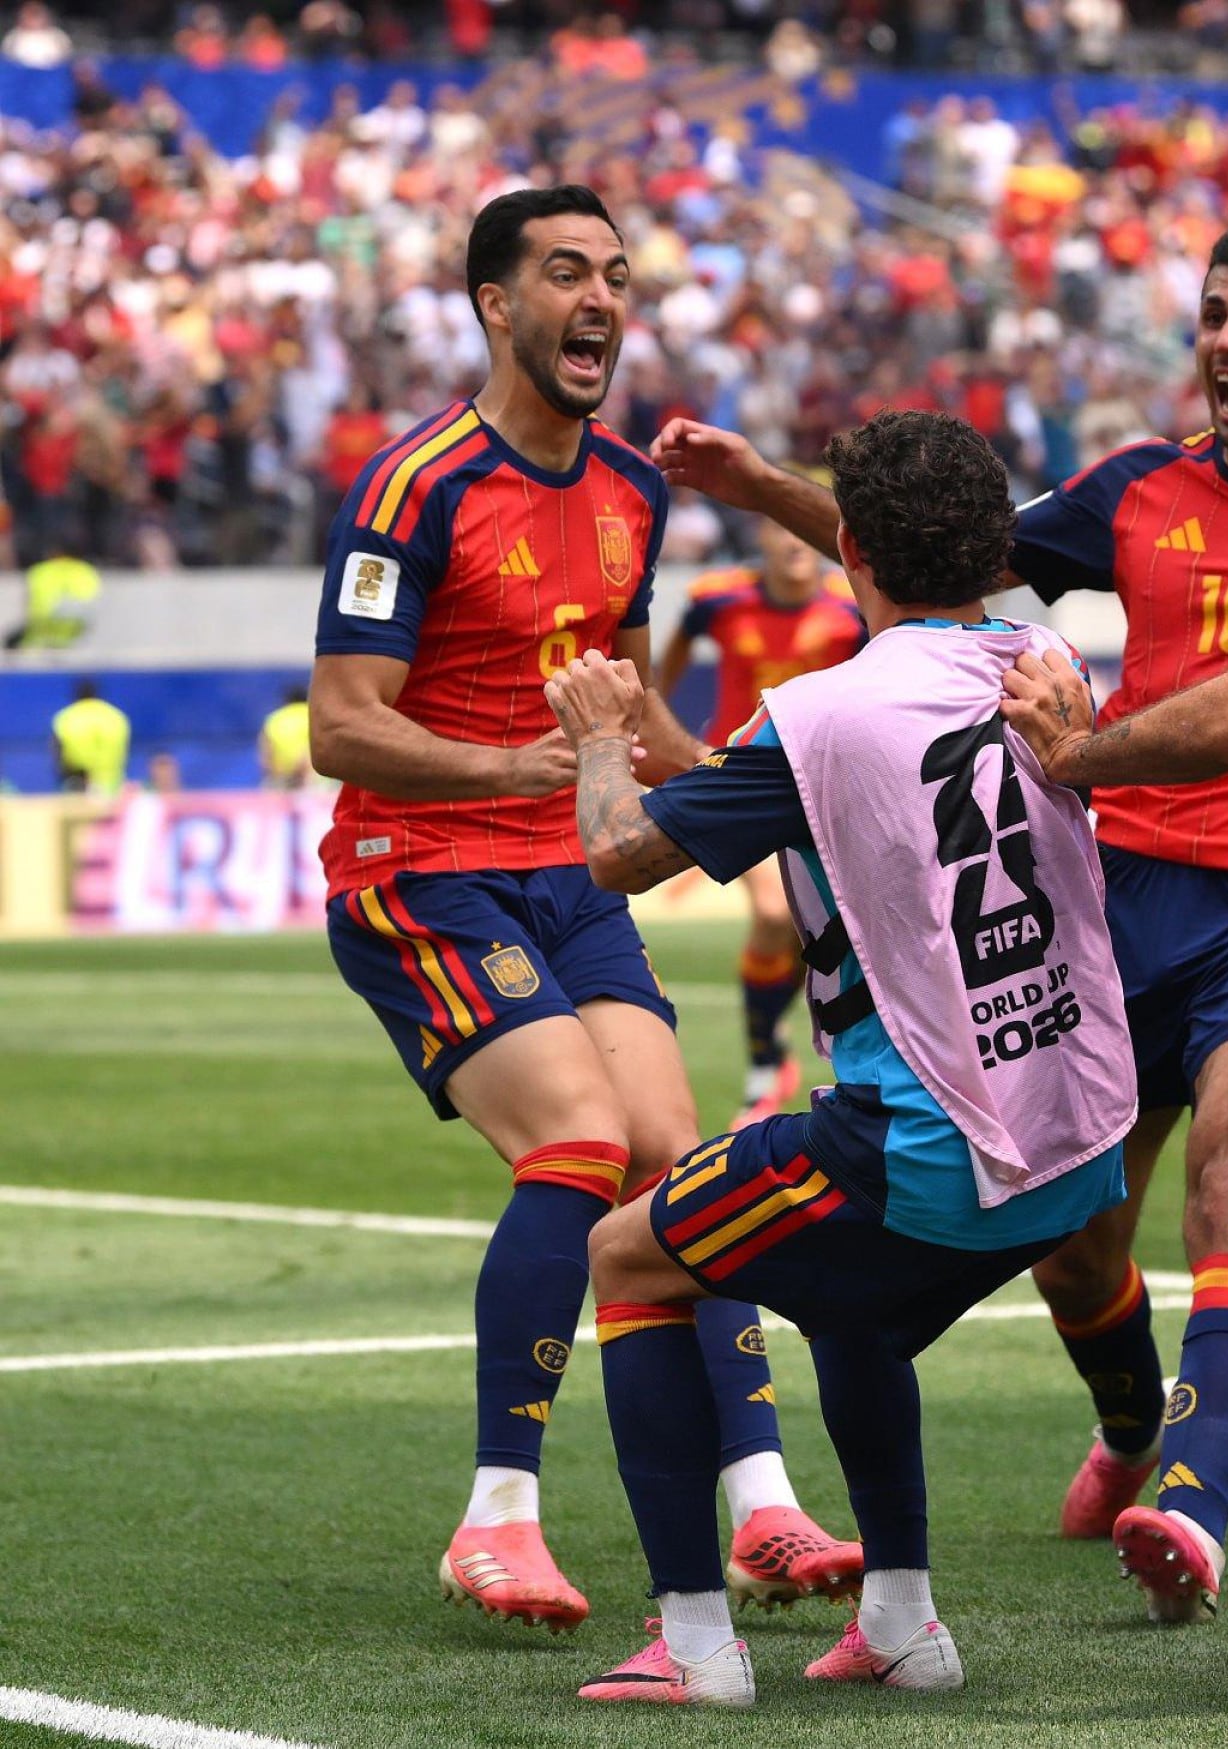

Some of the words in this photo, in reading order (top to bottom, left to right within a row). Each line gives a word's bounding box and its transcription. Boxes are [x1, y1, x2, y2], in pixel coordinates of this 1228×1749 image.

[538, 603, 585, 680] 6
[974, 914, 1042, 961] FIFA
[971, 983, 1044, 1025] ORLD
